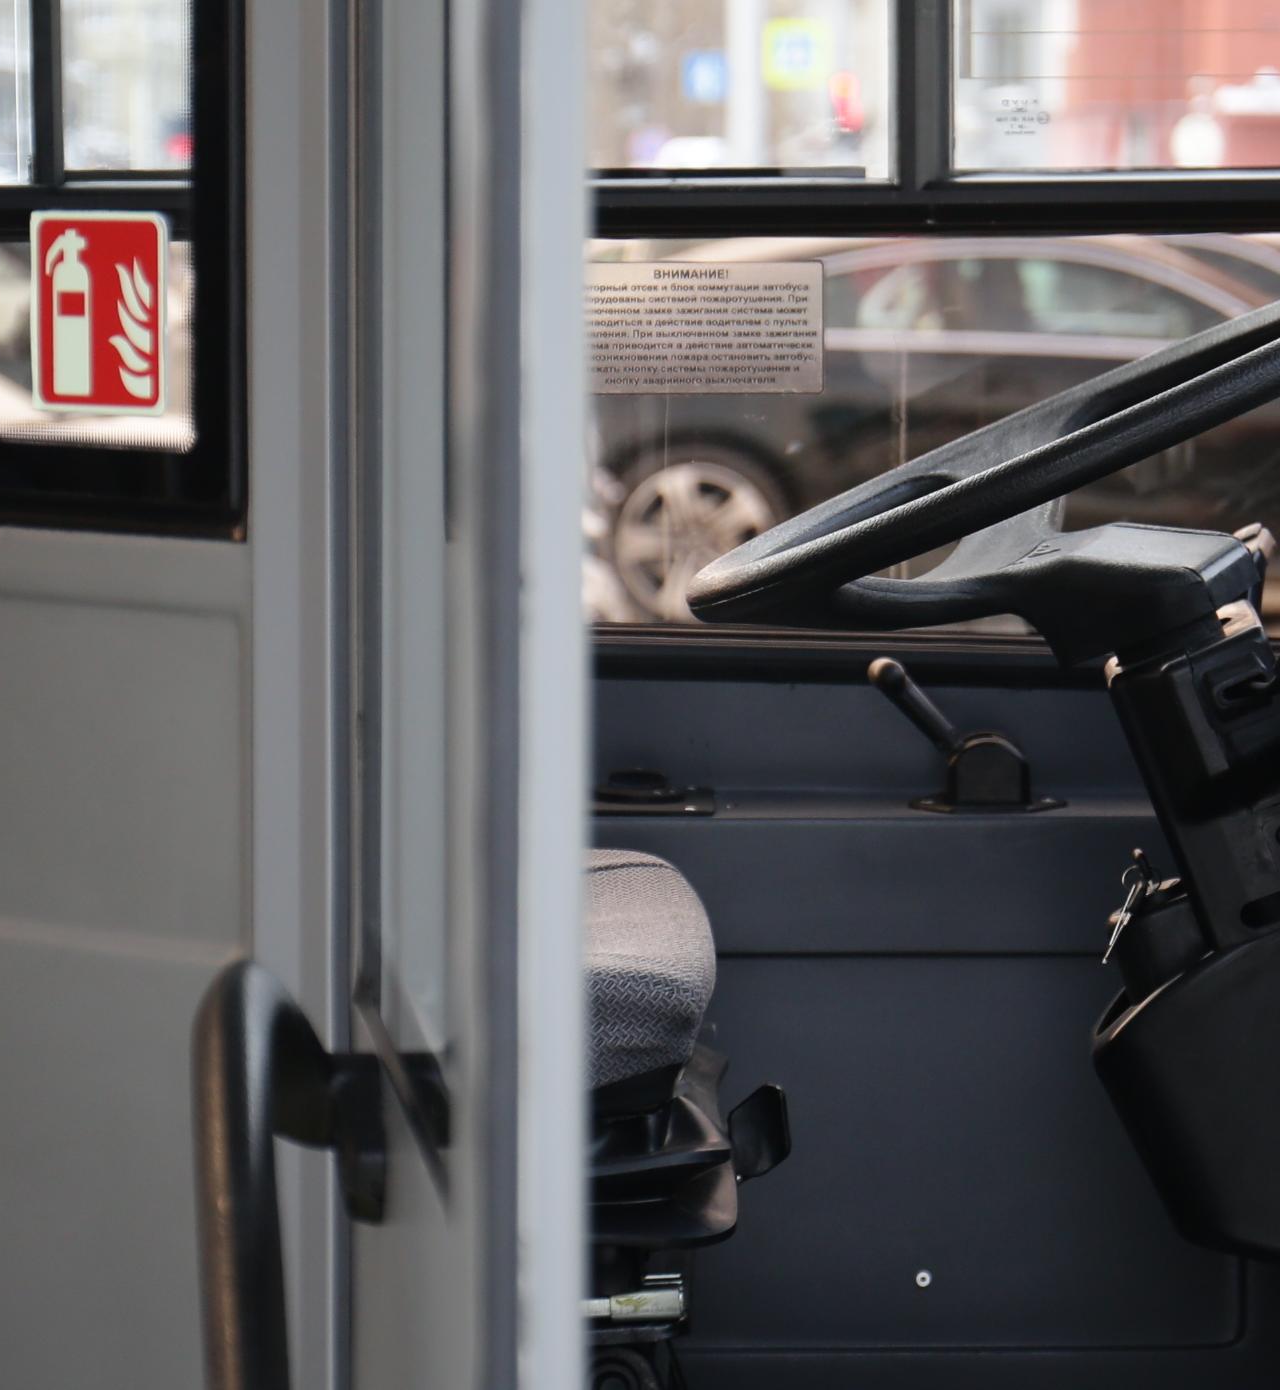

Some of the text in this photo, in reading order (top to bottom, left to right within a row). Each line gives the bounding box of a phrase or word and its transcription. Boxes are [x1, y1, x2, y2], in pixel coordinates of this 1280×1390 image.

[653, 269, 729, 280] ВНИМАНИЕ!
[670, 282, 696, 292] блок
[697, 284, 760, 293] коммутации
[762, 282, 809, 293] автобуса
[648, 295, 697, 303] системой
[787, 294, 808, 304] При
[654, 318, 703, 328] действие
[705, 319, 762, 327] водителем
[772, 320, 808, 328] пульта
[632, 329, 653, 339] При
[612, 342, 673, 351] приводится
[685, 341, 733, 351] действие
[670, 354, 709, 362] пожара
[622, 366, 658, 375] кнопку
[604, 377, 639, 386] кнопку
